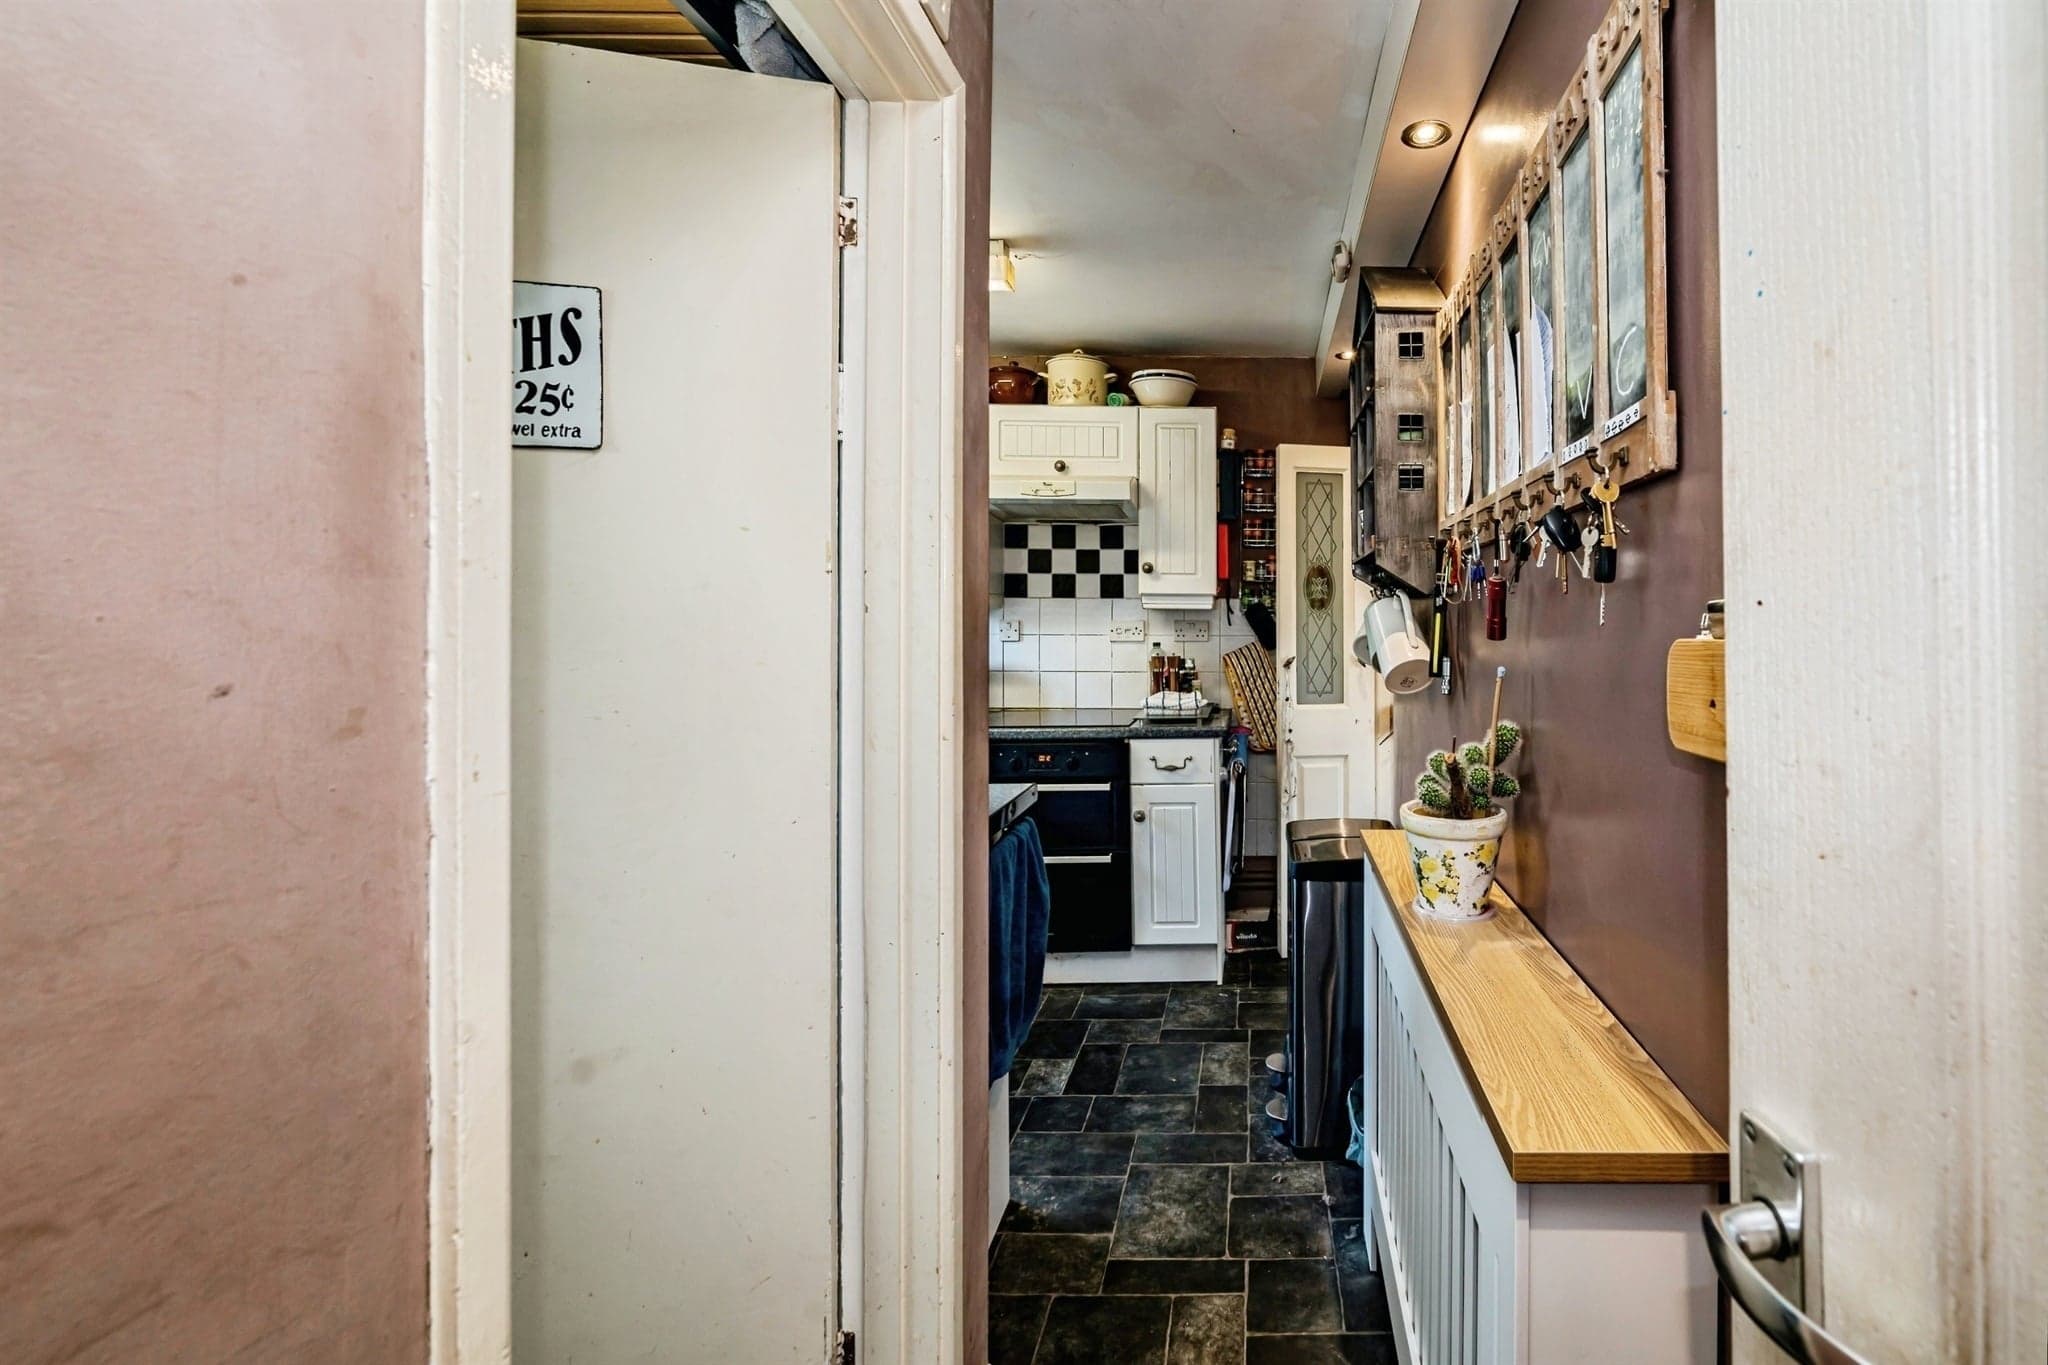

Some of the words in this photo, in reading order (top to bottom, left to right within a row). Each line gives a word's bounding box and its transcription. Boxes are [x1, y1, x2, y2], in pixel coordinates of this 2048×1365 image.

[512, 307, 583, 373] HS
[514, 379, 575, 417] 25¢
[541, 424, 581, 439] extra
